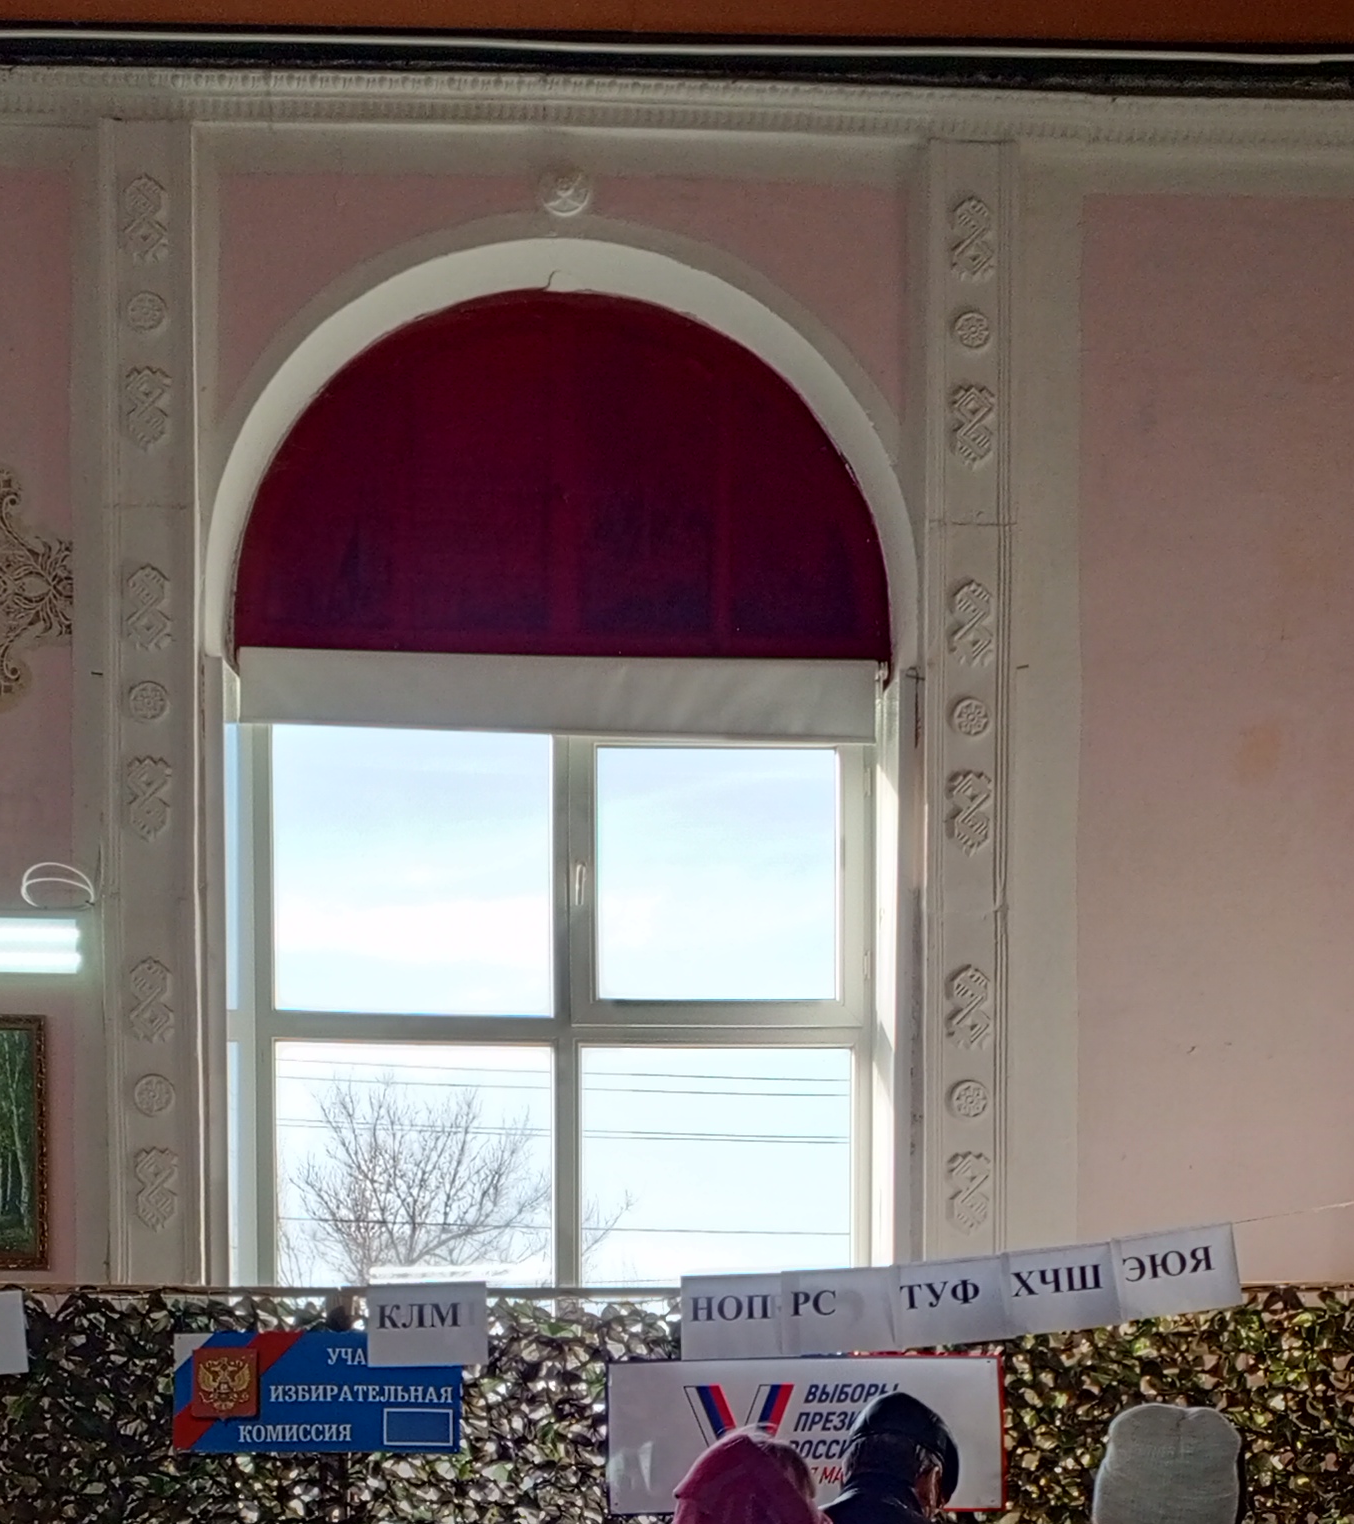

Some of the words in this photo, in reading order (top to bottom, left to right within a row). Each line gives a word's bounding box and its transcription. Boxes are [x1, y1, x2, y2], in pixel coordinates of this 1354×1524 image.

[1122, 1245, 1216, 1283] ЭЮЯ
[900, 1278, 980, 1310] ТУФ
[1011, 1264, 1104, 1297] ХЧШ
[376, 1302, 461, 1330] КЛМ
[690, 1294, 771, 1322] НОП
[790, 1289, 837, 1317] РС
[269, 1384, 453, 1403] ИЗБИРАТЕЛЬНАЯ
[238, 1424, 352, 1443] КОМИССИЯ
